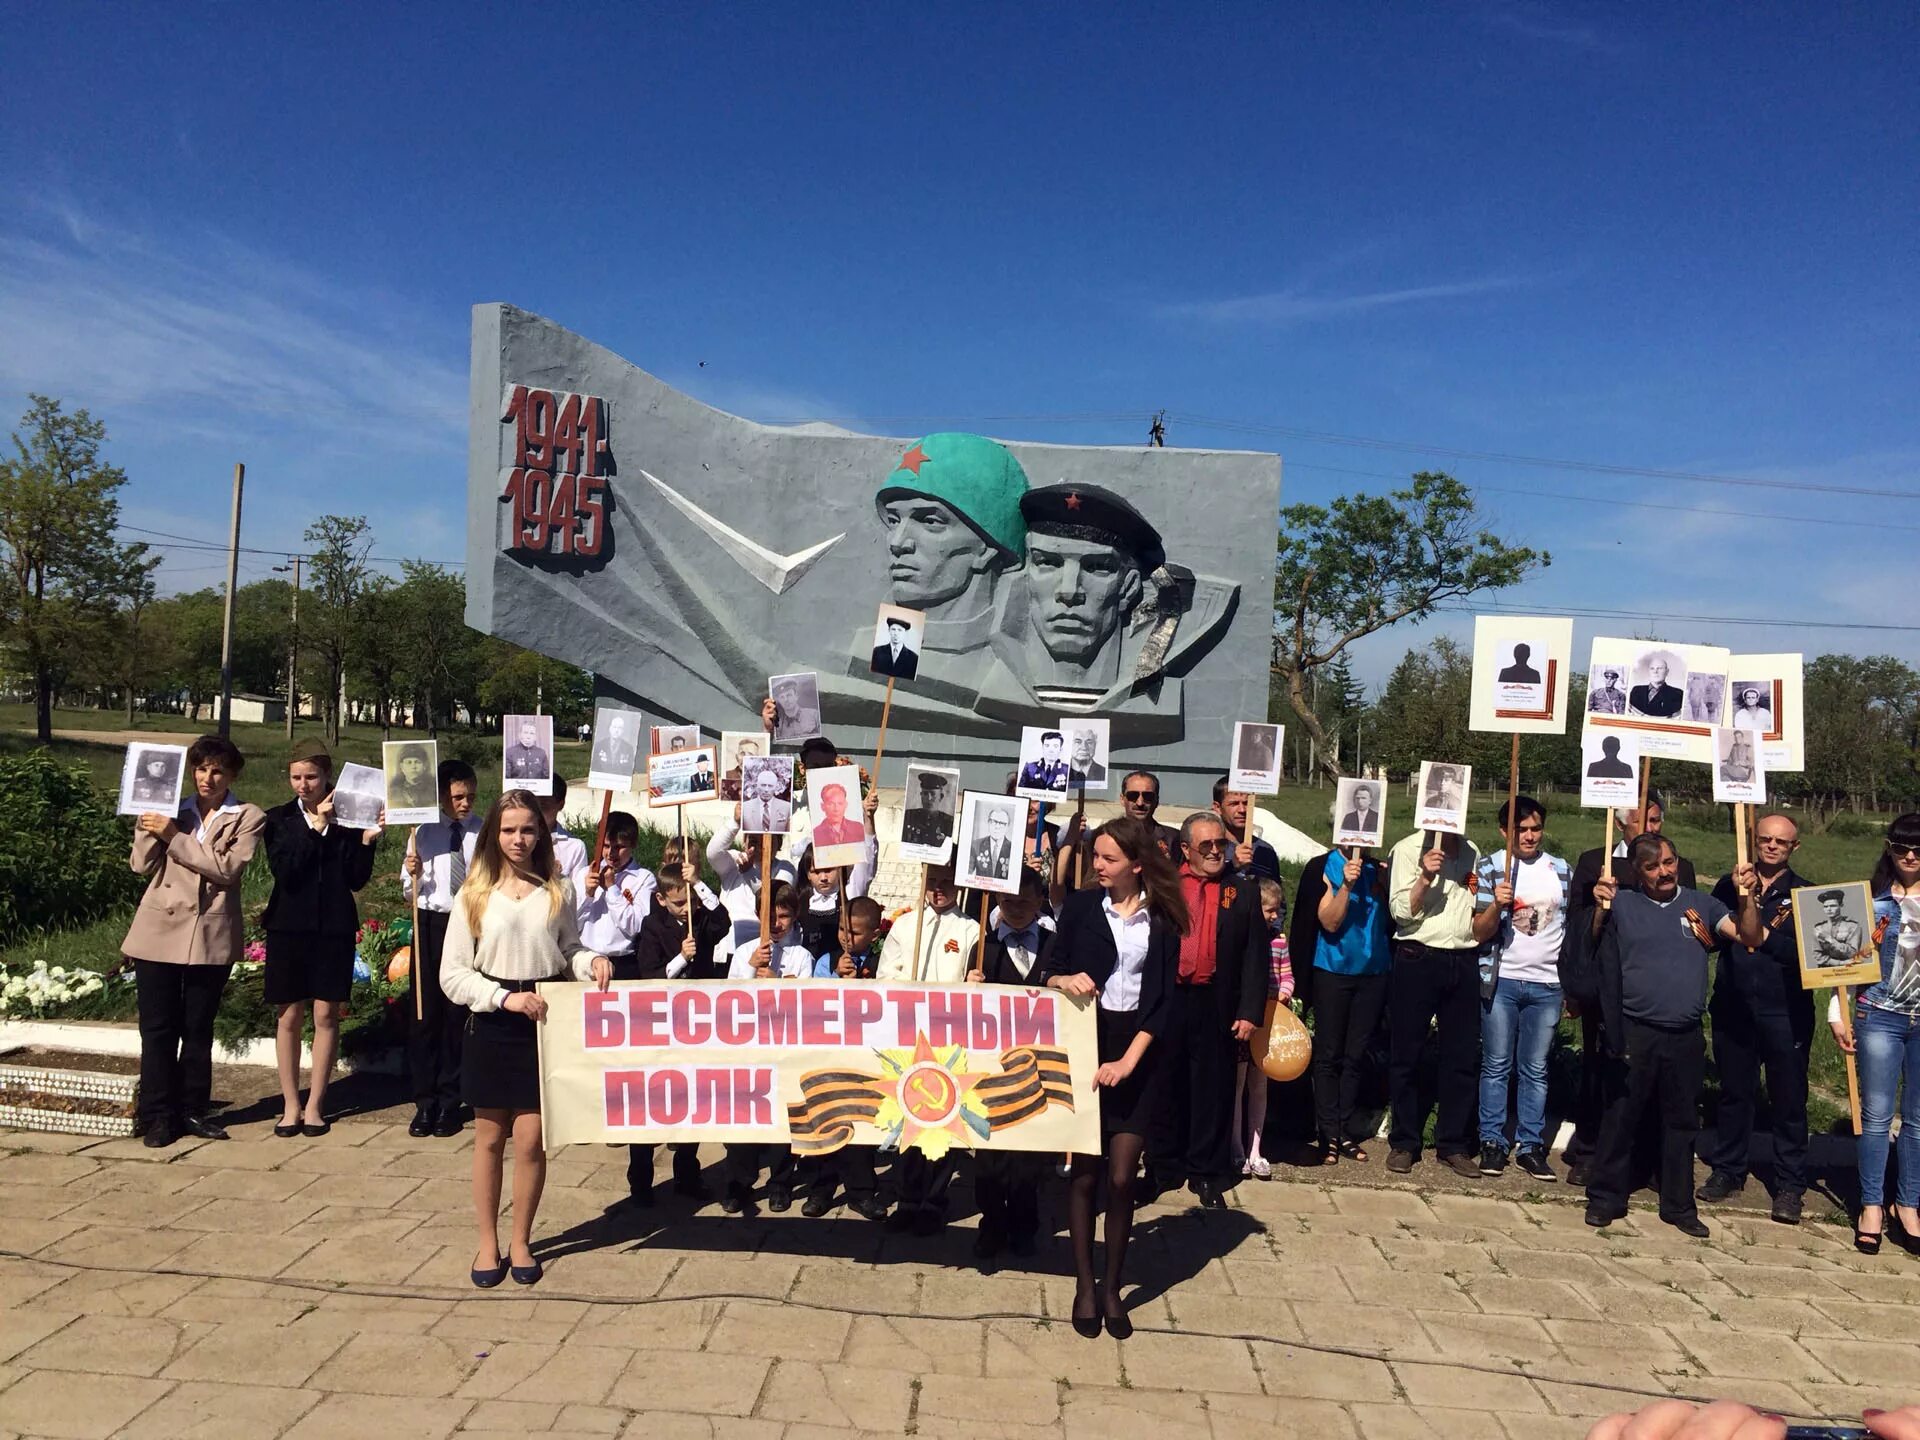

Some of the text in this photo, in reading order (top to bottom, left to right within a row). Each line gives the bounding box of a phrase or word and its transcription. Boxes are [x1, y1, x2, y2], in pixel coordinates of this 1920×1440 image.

[500, 467, 606, 556] 1945
[584, 988, 1056, 1050] БЕССМЕРТНЫЙ
[605, 1068, 774, 1127] ПОЛК
